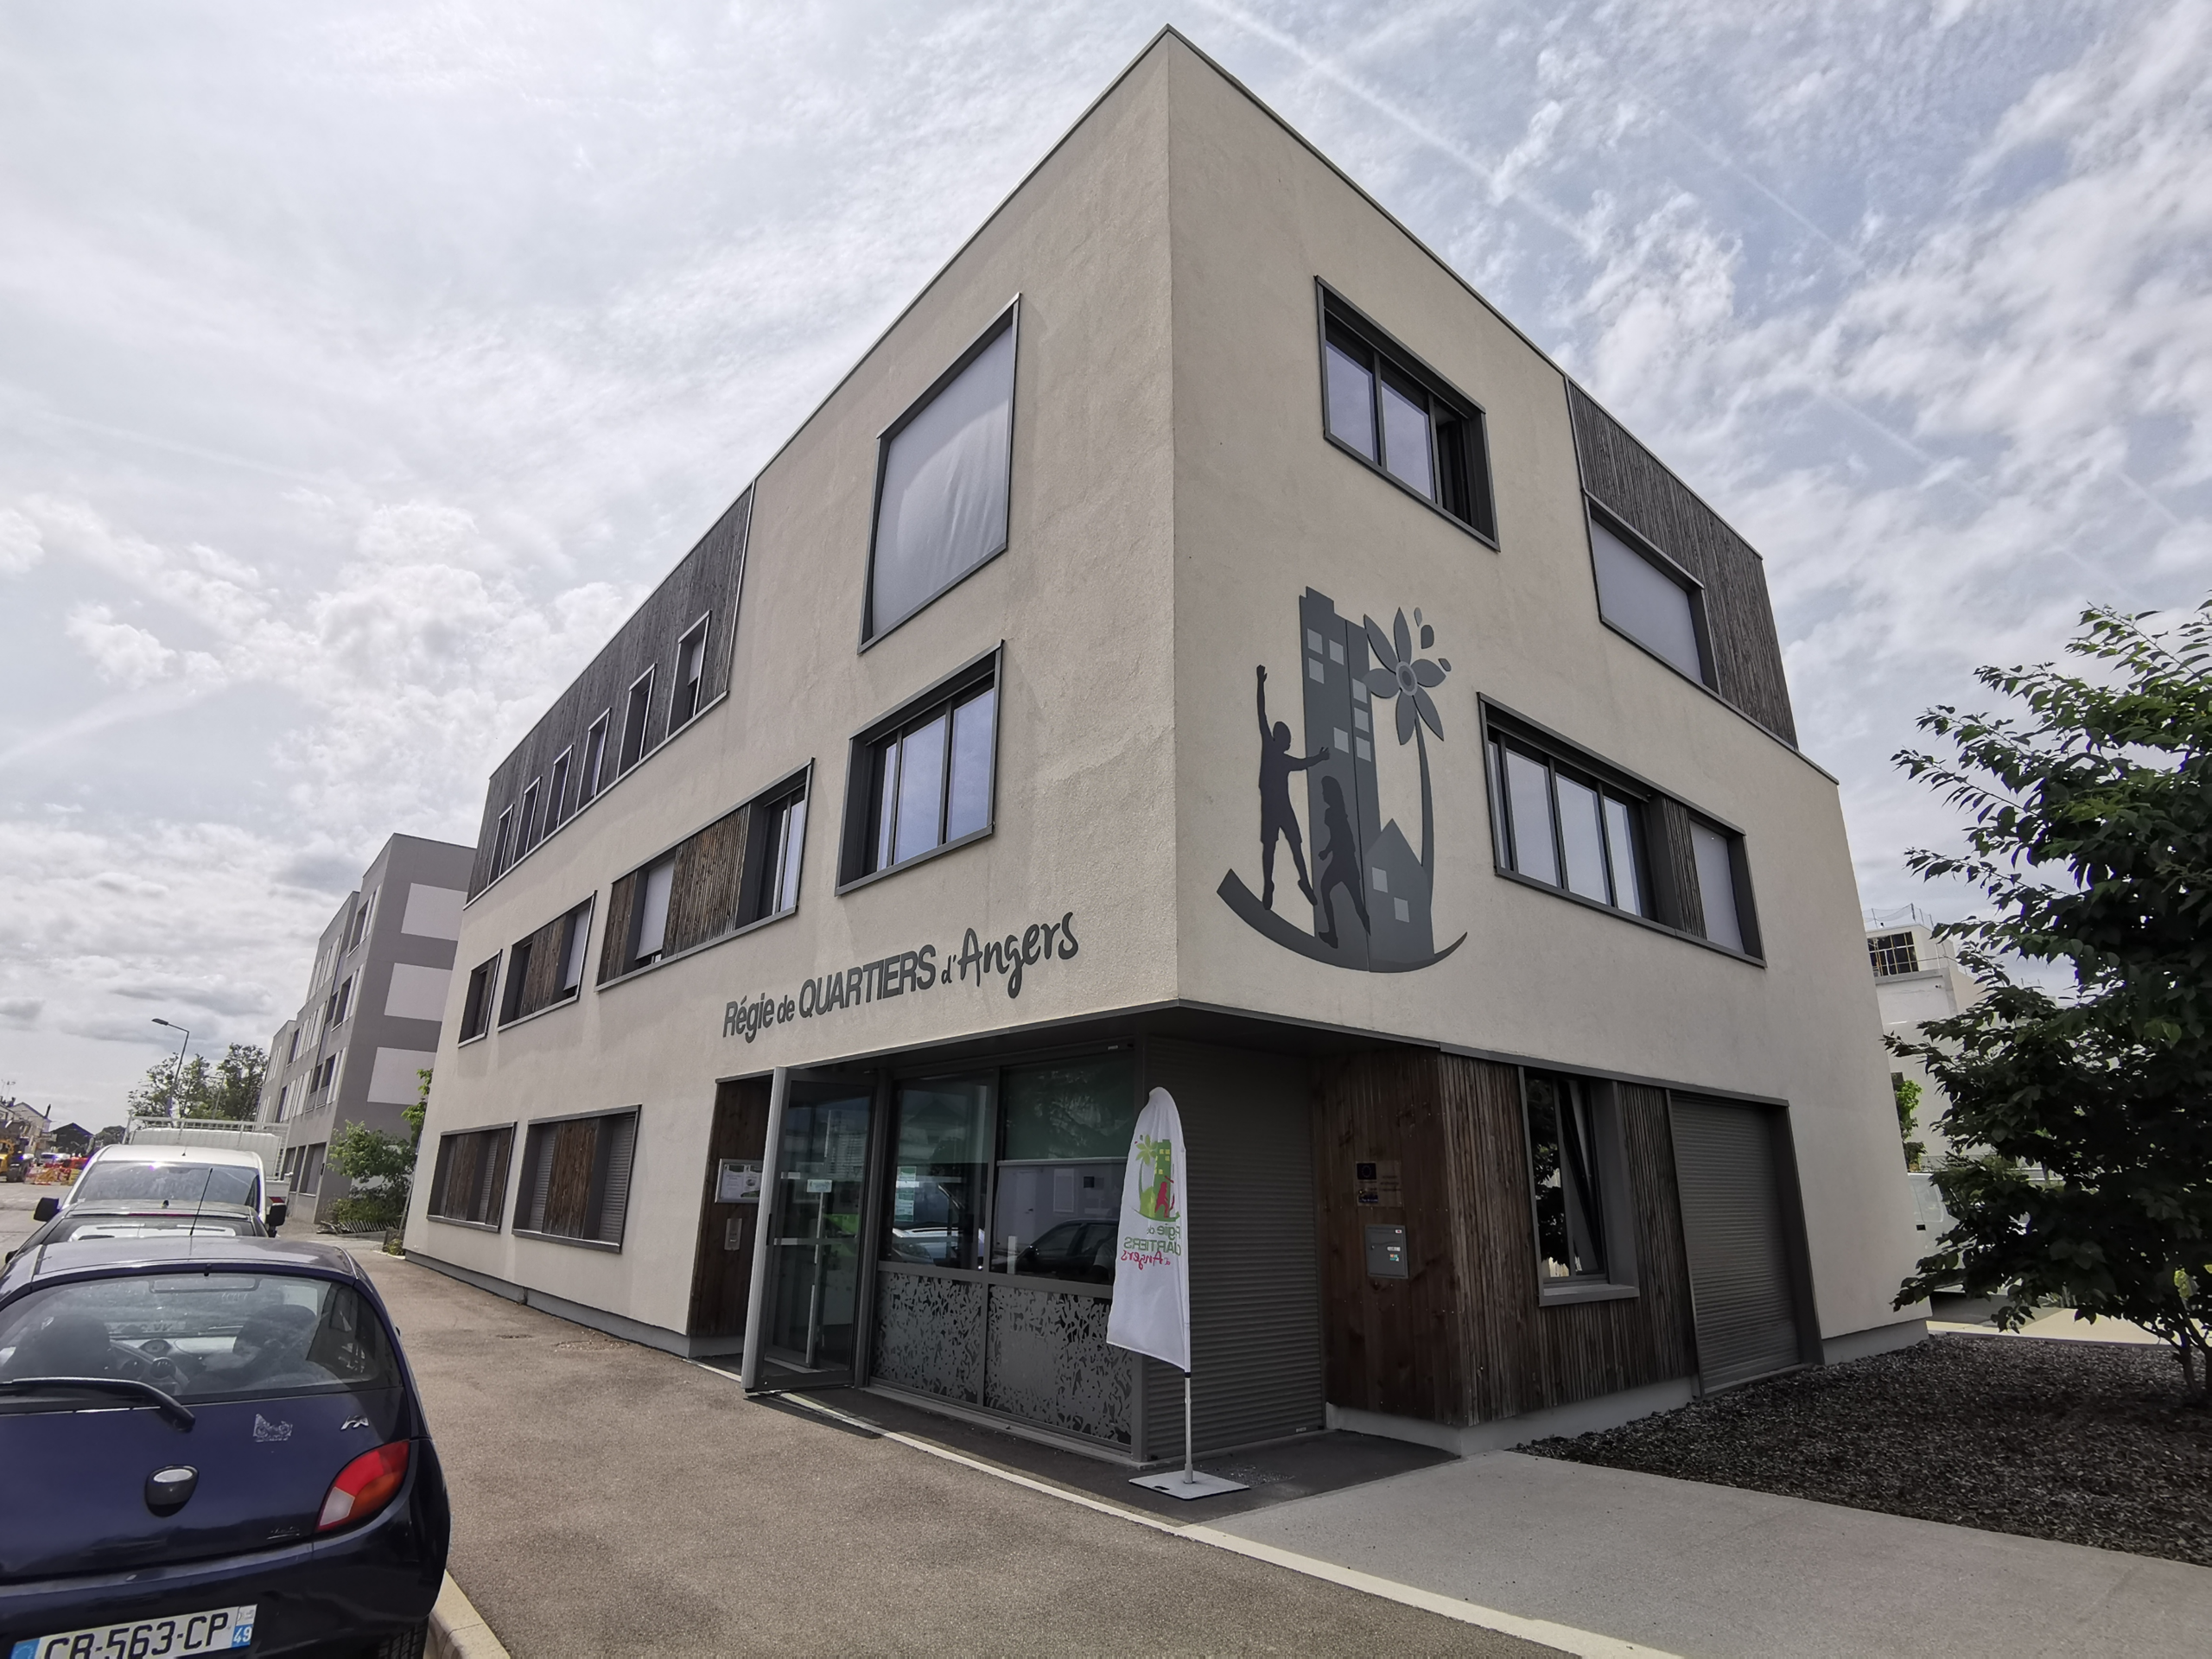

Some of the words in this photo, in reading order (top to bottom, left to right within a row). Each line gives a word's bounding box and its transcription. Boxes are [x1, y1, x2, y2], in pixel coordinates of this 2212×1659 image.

[723, 995, 774, 1044] Régie
[777, 999, 795, 1025] de
[799, 944, 936, 1018] QUARTIERS
[233, 1626, 252, 1643] 49
